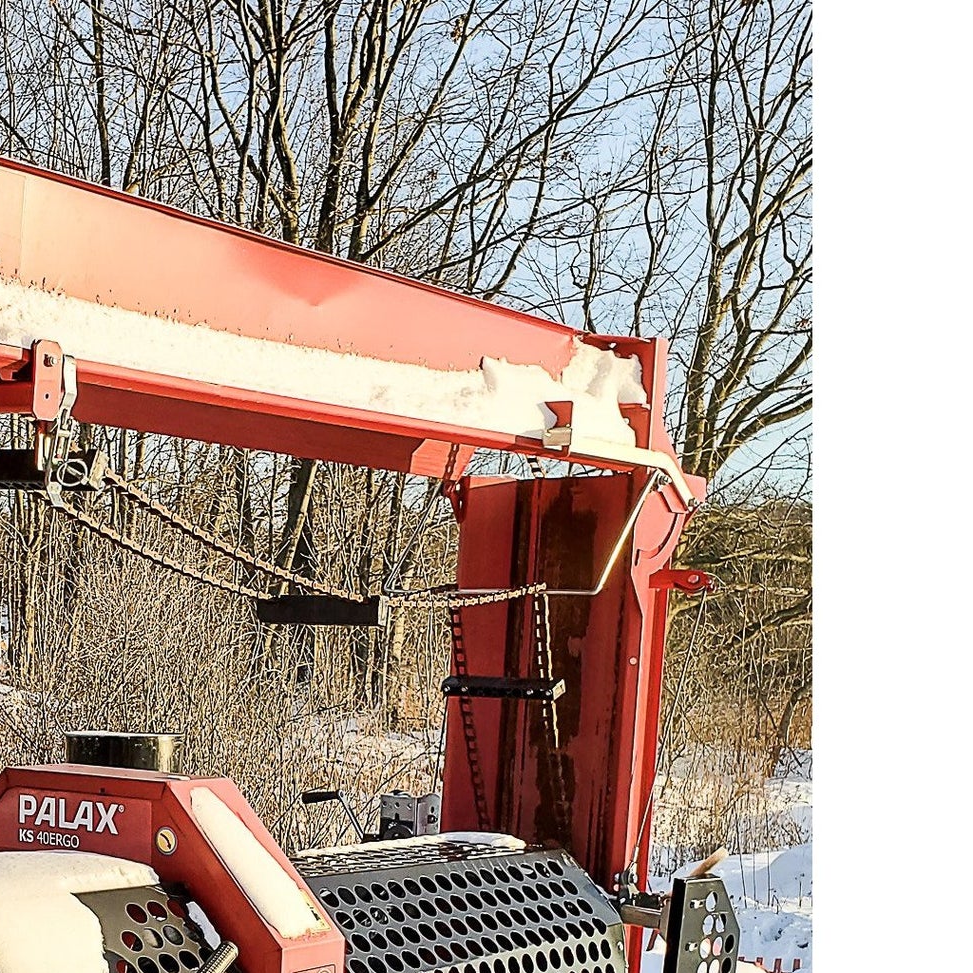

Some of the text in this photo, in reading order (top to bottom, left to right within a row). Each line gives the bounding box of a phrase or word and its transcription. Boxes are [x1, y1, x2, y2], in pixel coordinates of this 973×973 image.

[18, 794, 121, 835] PALAX
[18, 829, 80, 848] KS 40ERGO
